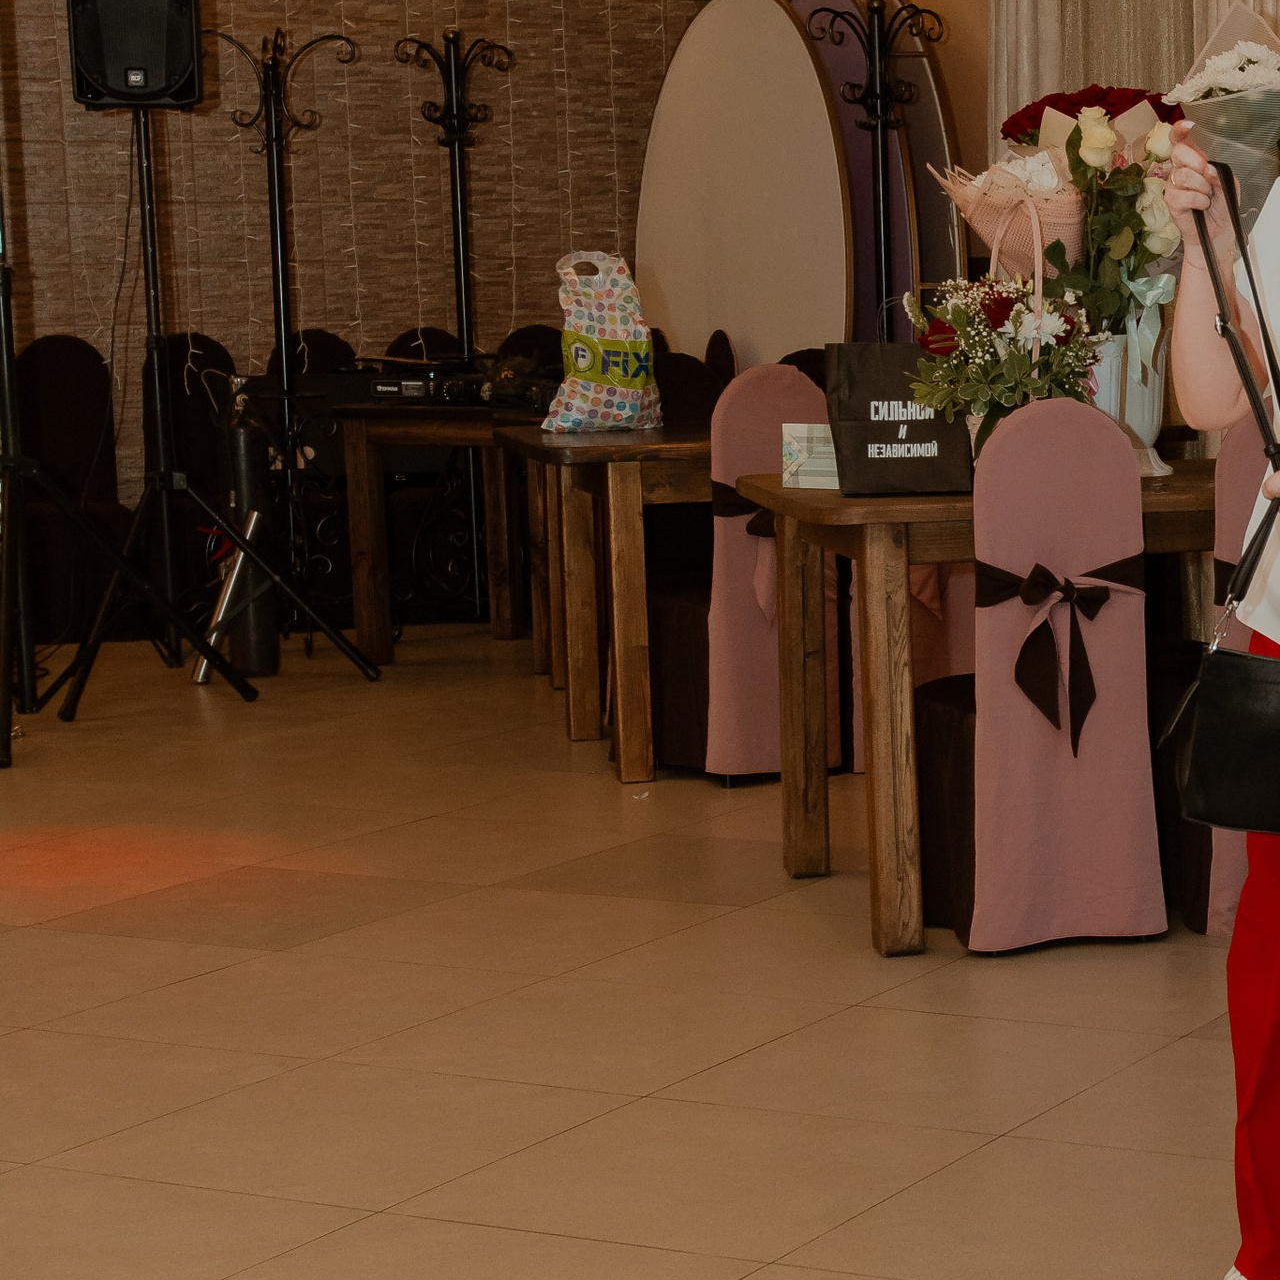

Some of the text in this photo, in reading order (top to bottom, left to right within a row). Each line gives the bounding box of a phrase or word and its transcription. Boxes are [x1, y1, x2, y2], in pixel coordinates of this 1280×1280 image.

[601, 350, 650, 379] FIX
[897, 424, 908, 440] И
[867, 440, 938, 458] НЕЗАВИСИМОЙ
